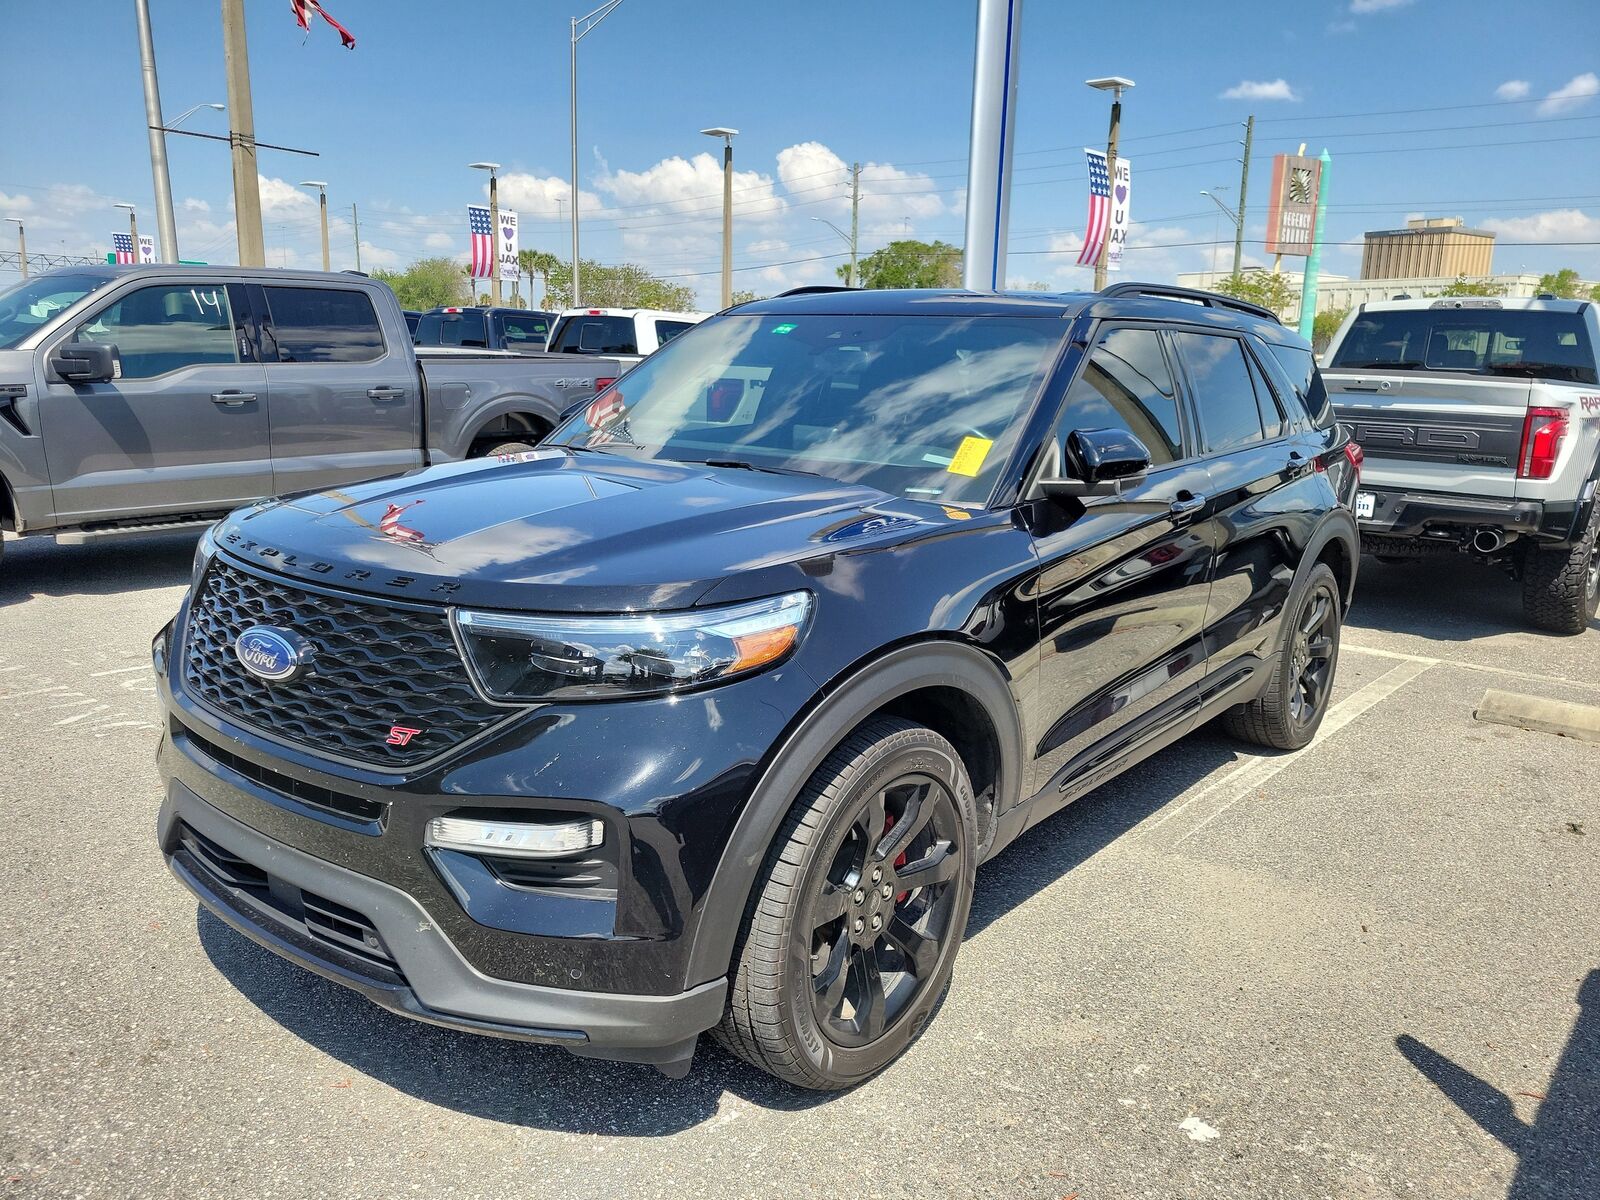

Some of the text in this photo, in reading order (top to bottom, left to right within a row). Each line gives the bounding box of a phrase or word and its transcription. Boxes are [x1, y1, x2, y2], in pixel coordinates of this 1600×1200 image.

[1115, 166, 1129, 181] WE
[500, 215, 517, 226] WE
[1115, 210, 1124, 224] U
[1283, 211, 1312, 229] REGENCY
[139, 238, 153, 246] WE
[1281, 227, 1310, 244] SQUARE
[505, 243, 513, 253] U
[499, 254, 519, 266] JAX
[190, 289, 222, 317] 14
[226, 533, 462, 594] EXPLORER
[244, 638, 280, 669] Ford
[385, 726, 423, 746] ST
